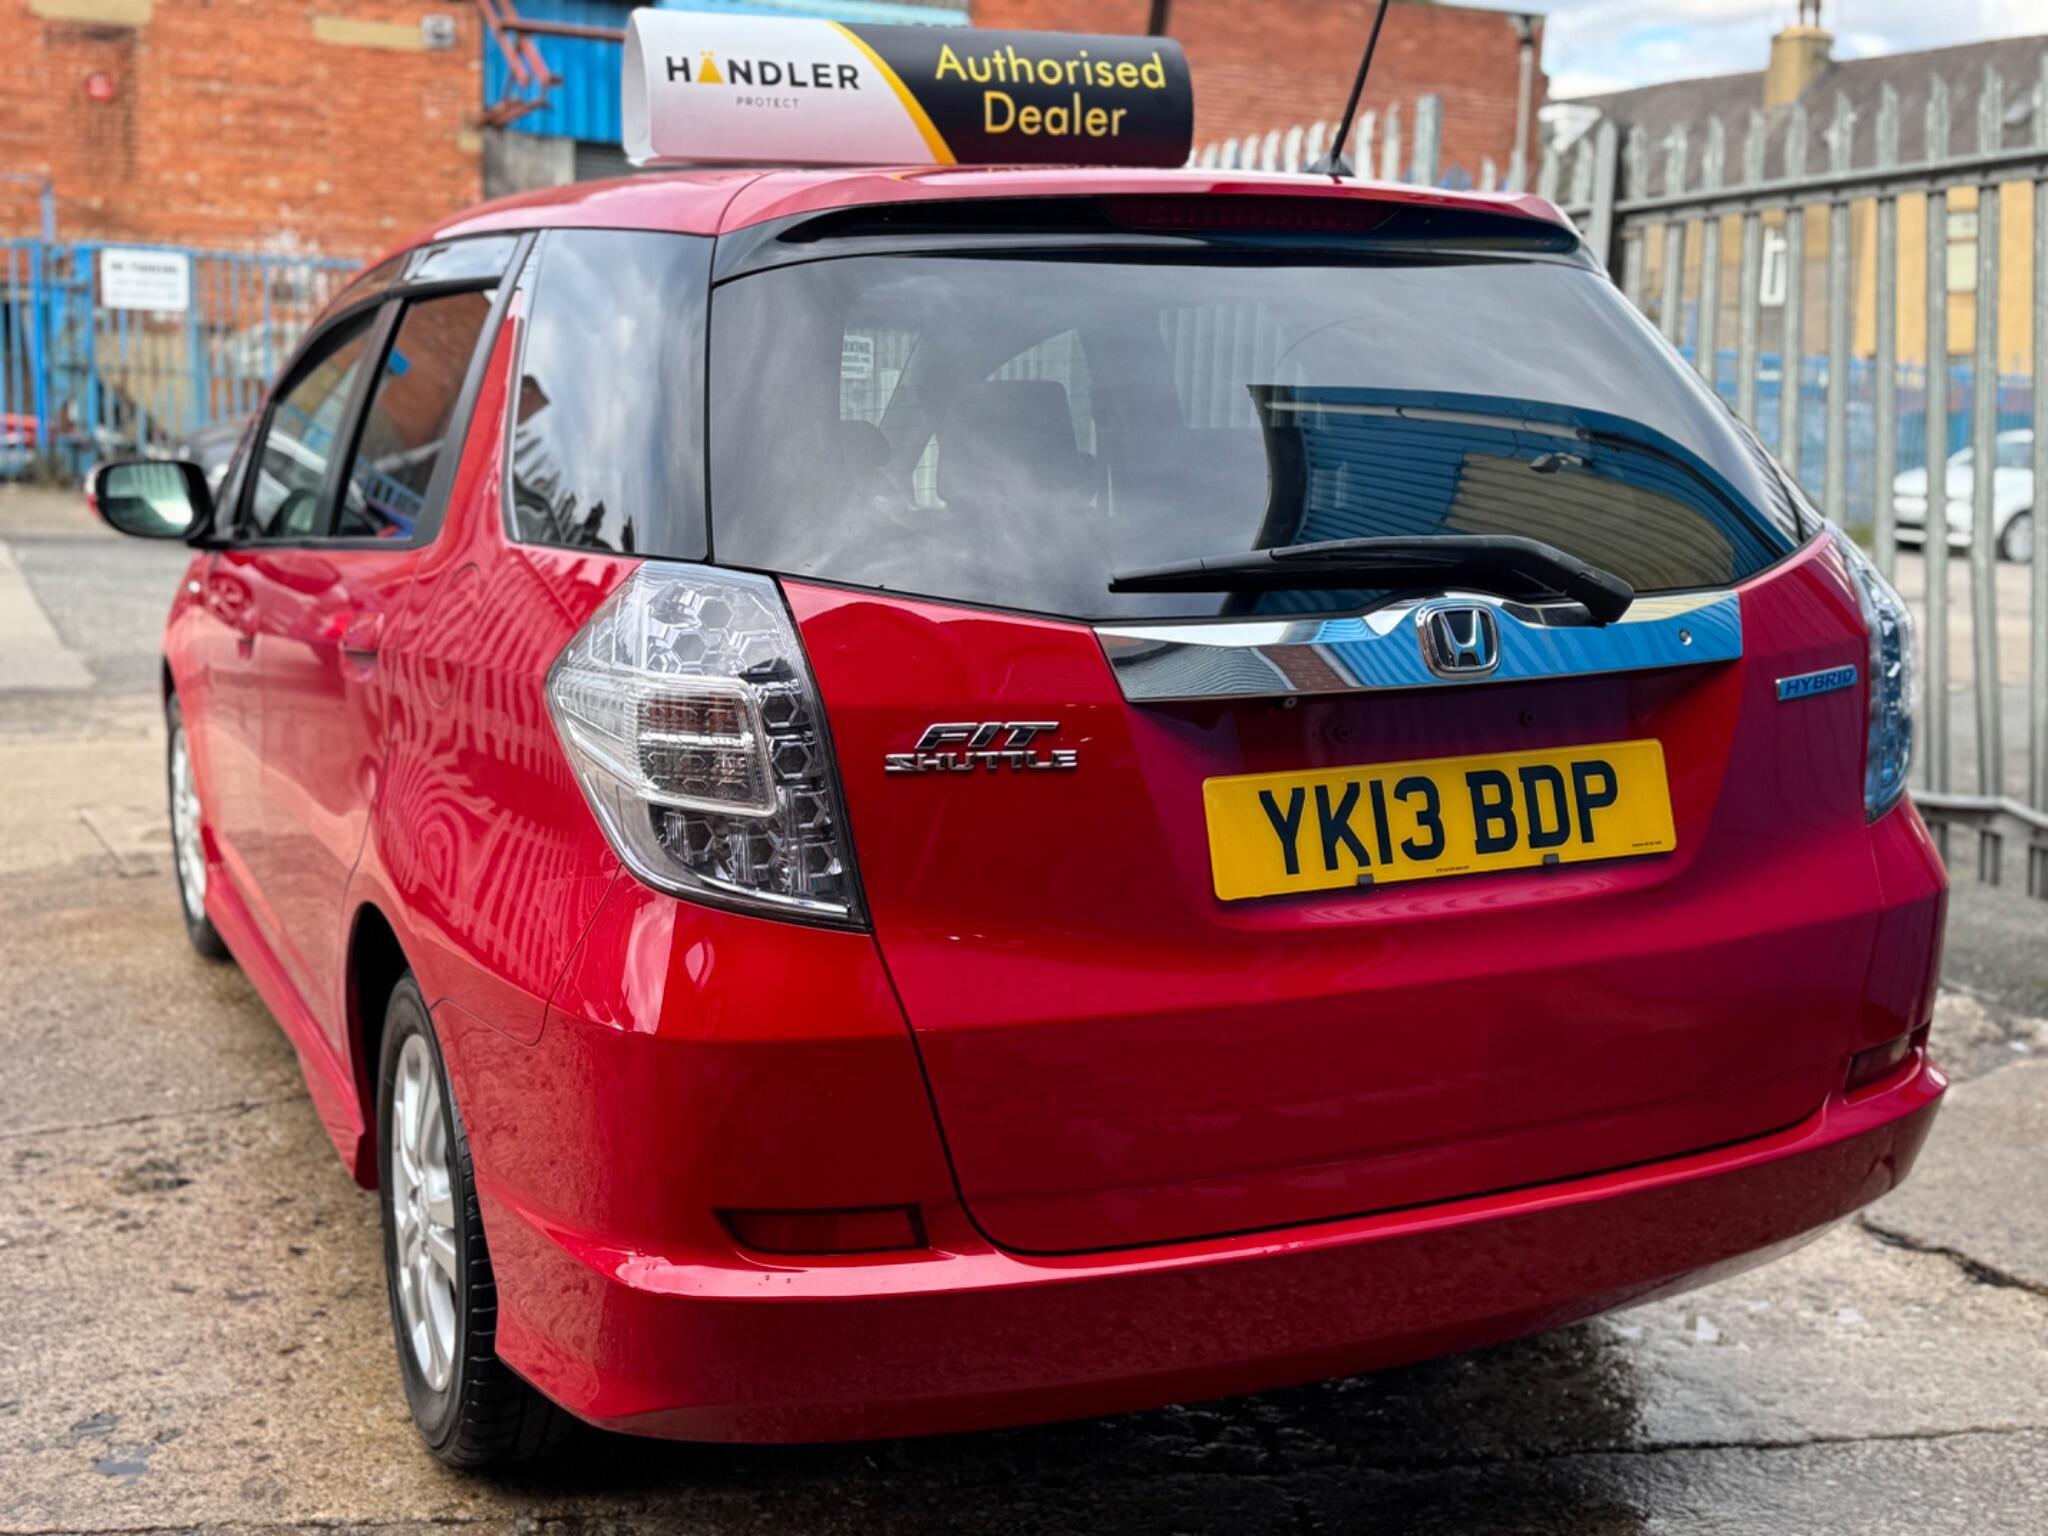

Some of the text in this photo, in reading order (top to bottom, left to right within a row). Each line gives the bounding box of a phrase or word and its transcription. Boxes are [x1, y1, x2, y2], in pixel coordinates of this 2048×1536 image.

[935, 43, 1167, 89] Authorised
[736, 96, 800, 109] PROTECT
[983, 90, 1128, 137] Dealer
[1785, 668, 1855, 696] HYBRID
[914, 721, 1060, 750] FIT
[884, 750, 1078, 772] SHUTTLE
[1258, 760, 1619, 875] YK13 BDP
